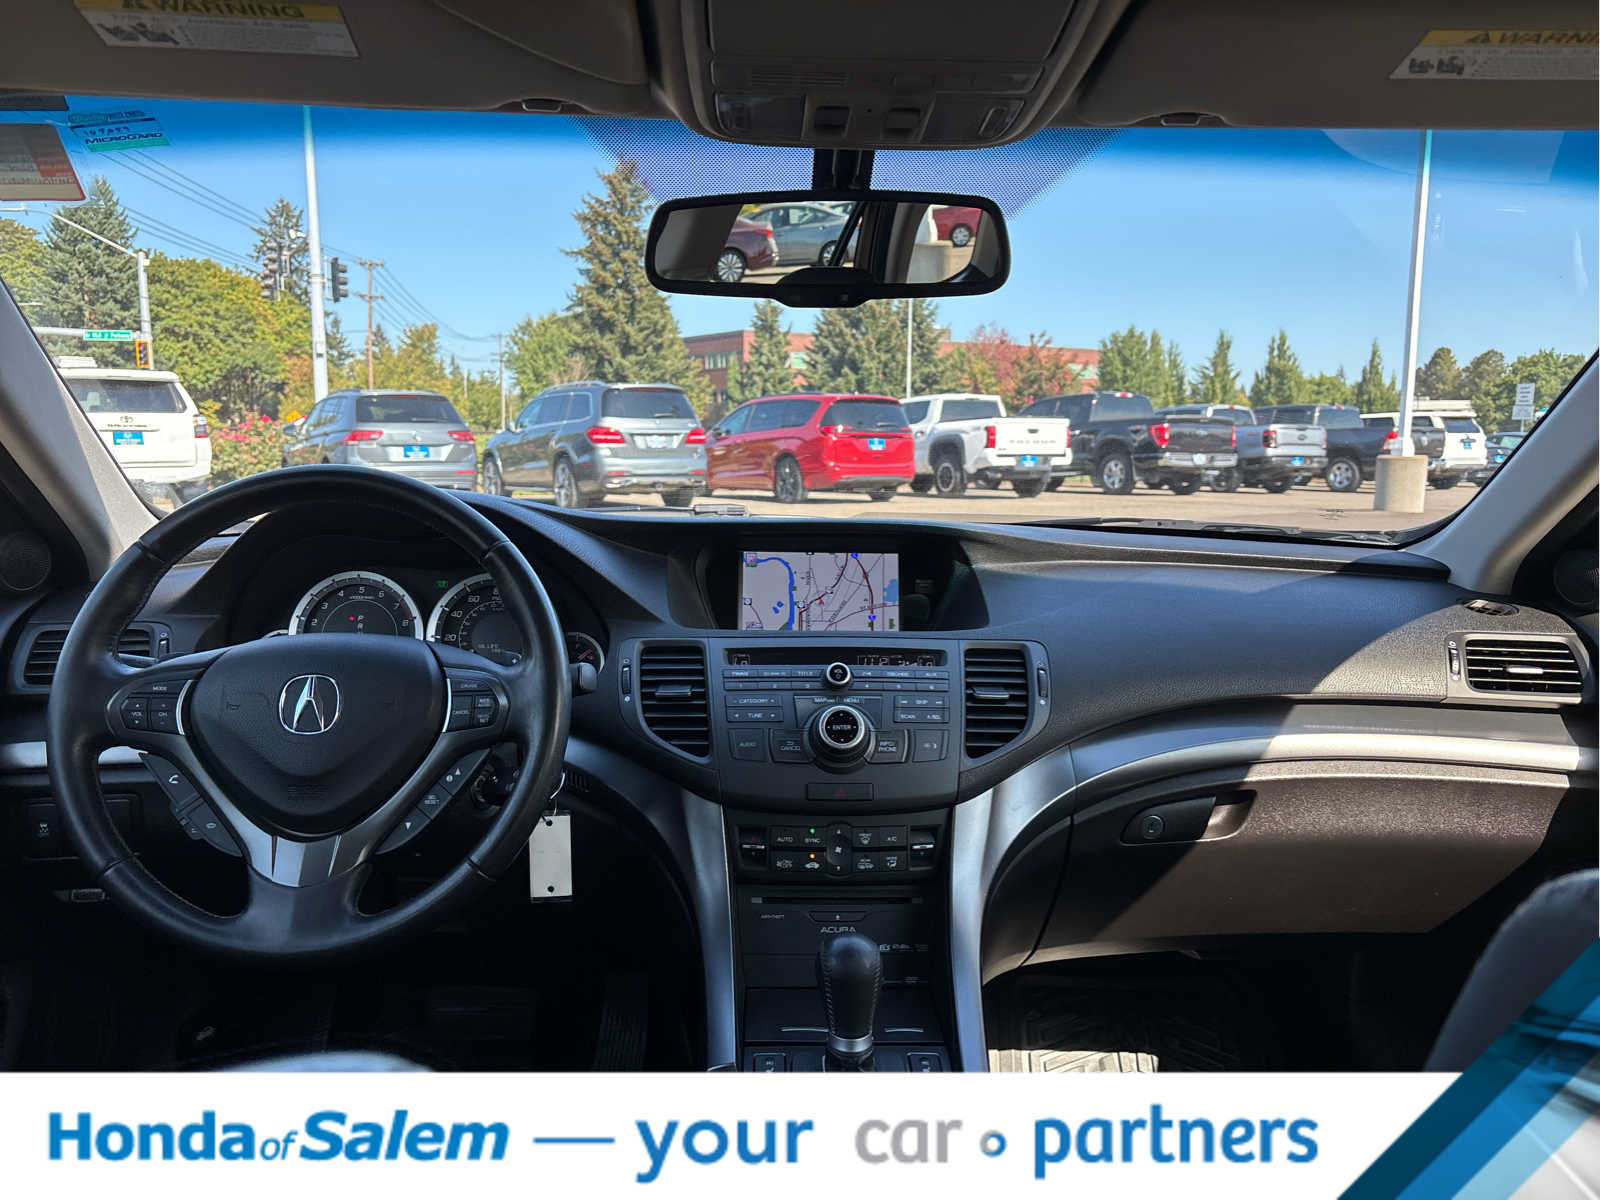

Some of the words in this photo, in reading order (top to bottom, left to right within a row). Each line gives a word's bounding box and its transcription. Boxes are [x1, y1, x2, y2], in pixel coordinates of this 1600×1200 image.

[148, 0, 304, 17] WARNING
[378, 590, 385, 598] 6
[468, 595, 481, 603] 60
[321, 602, 329, 610] 3
[451, 610, 464, 618] 40
[311, 618, 318, 626] 2
[820, 926, 857, 934] ACURA
